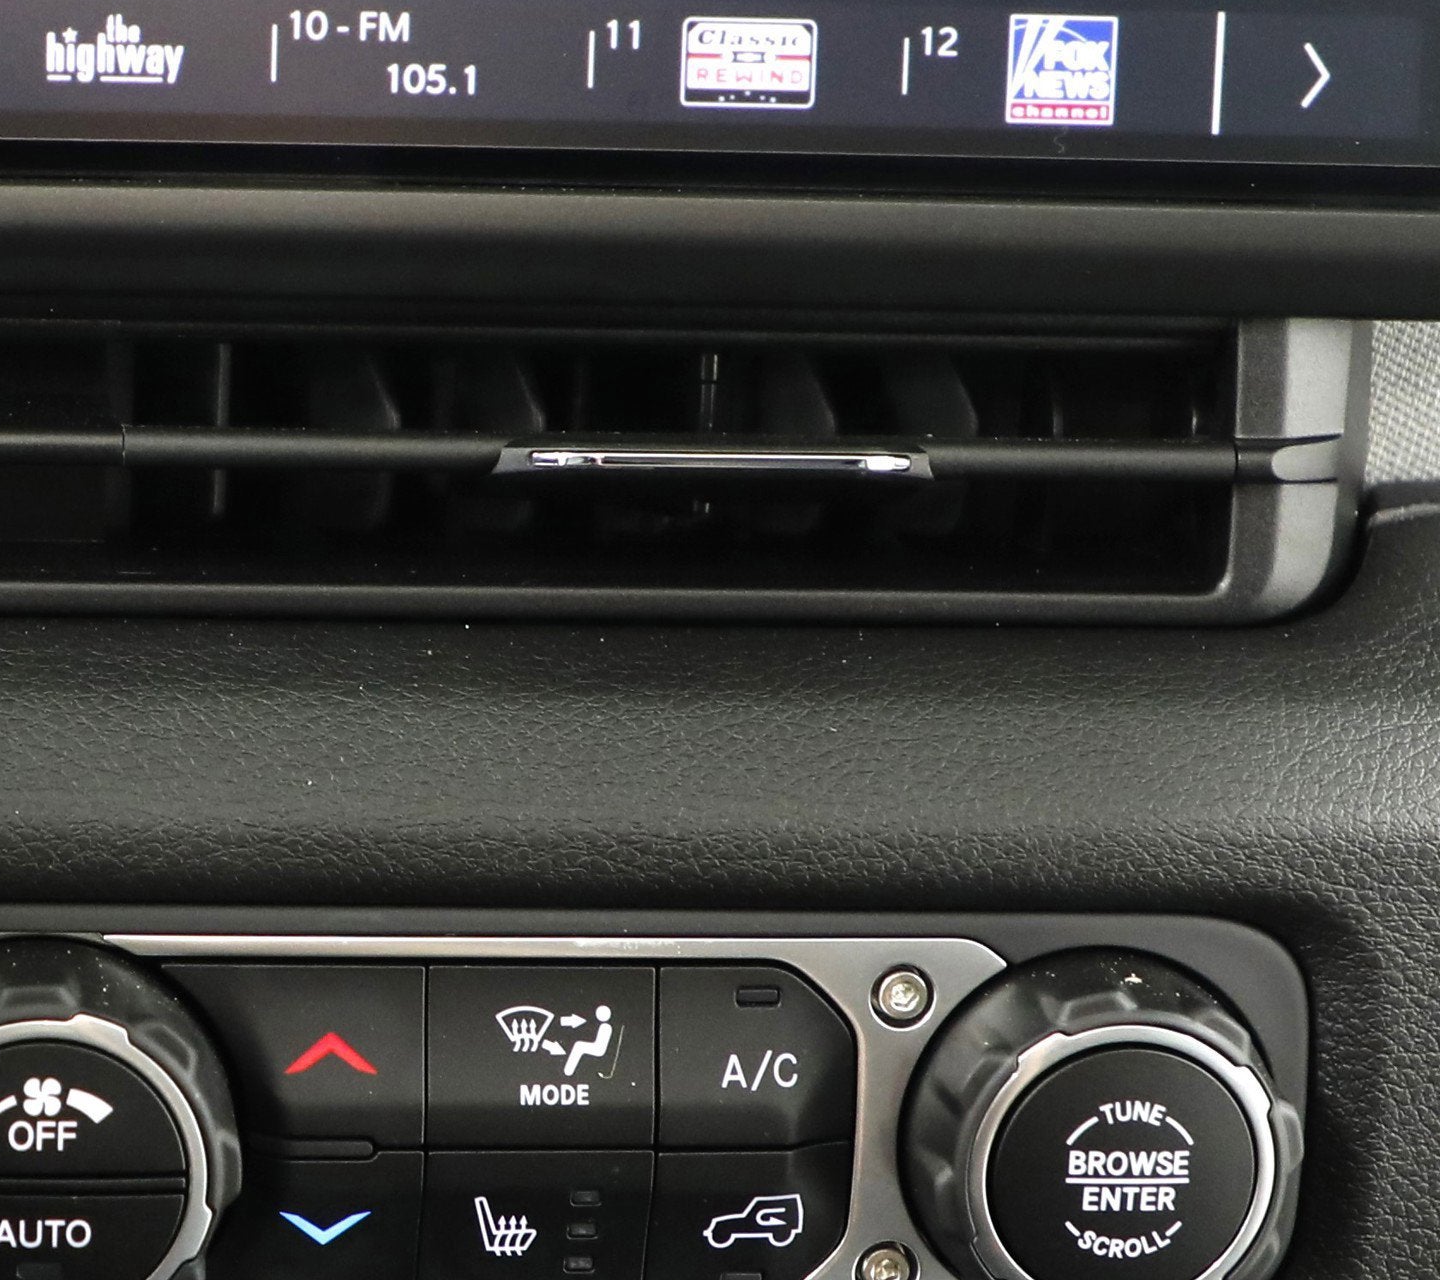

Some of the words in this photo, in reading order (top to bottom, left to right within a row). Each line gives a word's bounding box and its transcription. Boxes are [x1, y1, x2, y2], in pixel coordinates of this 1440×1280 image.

[106, 13, 142, 44] the
[289, 12, 328, 42] 10
[358, 12, 411, 44] FM
[606, 20, 644, 51] 11
[921, 27, 959, 58] 12
[46, 31, 185, 84] highway
[1043, 39, 1111, 72] FOX
[386, 63, 479, 96] 105.1
[695, 68, 806, 85] REWIND
[1022, 70, 1111, 100] NEWS
[1011, 105, 1110, 120] channel
[721, 1052, 798, 1090] A/C
[519, 1084, 589, 1107] MODE
[1099, 1101, 1166, 1128] TUNE
[8, 1121, 77, 1152] OFF
[1068, 1149, 1189, 1177] BROWSE
[1081, 1186, 1175, 1212] ENTER
[1077, 1228, 1164, 1258] SCROLL
